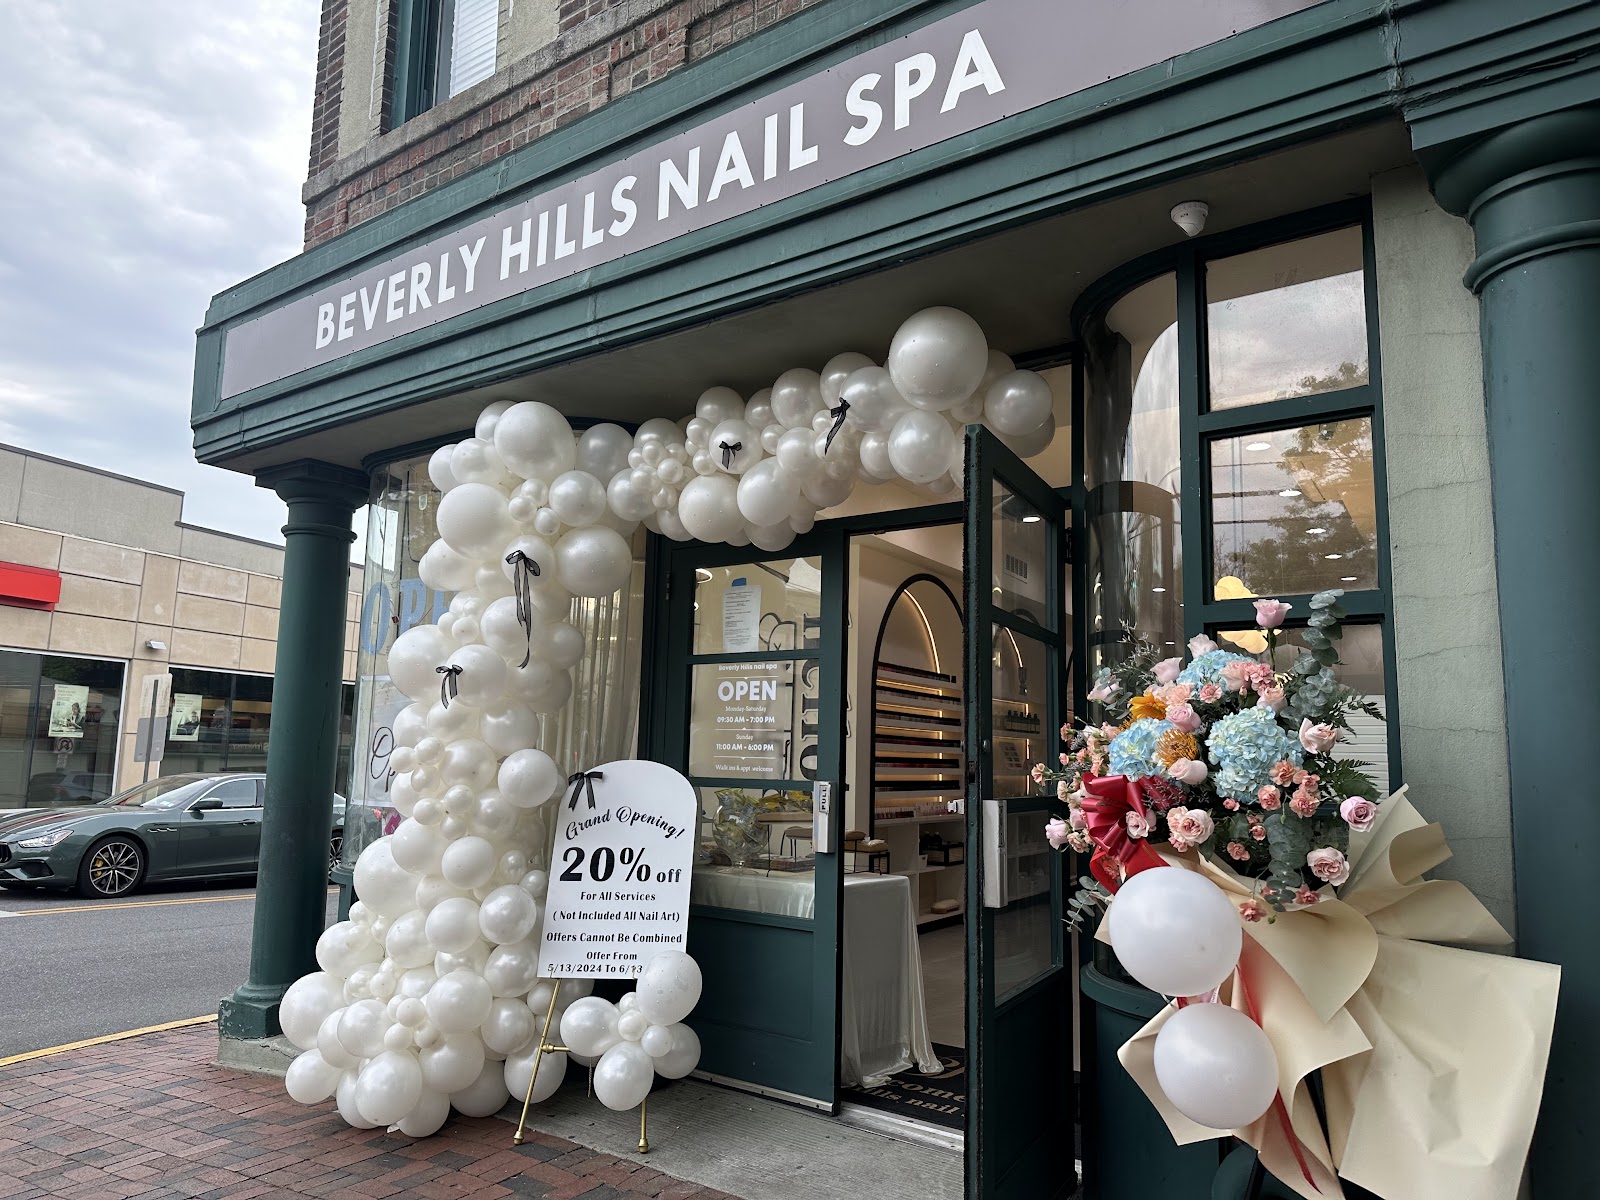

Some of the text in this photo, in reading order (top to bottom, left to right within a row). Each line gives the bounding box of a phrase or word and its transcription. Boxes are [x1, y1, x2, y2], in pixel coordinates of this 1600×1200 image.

[315, 28, 1006, 349] BEVERLY HILLS NAIL SPA
[717, 680, 777, 702] OPEN
[736, 733, 754, 741] Sunday
[565, 806, 685, 841] Grand Opening!
[560, 847, 682, 883] 20% off
[580, 892, 656, 901] For All Services
[578, 911, 621, 920] Included
[623, 911, 636, 921] All
[638, 912, 658, 921] Nail
[660, 912, 680, 922] Art)
[546, 932, 682, 943] Offers Cannot Be Combined
[586, 951, 638, 960] Offer From
[547, 963, 602, 973] 5/13/2024
[605, 965, 616, 973] To
[905, 1098, 960, 1115] nail
